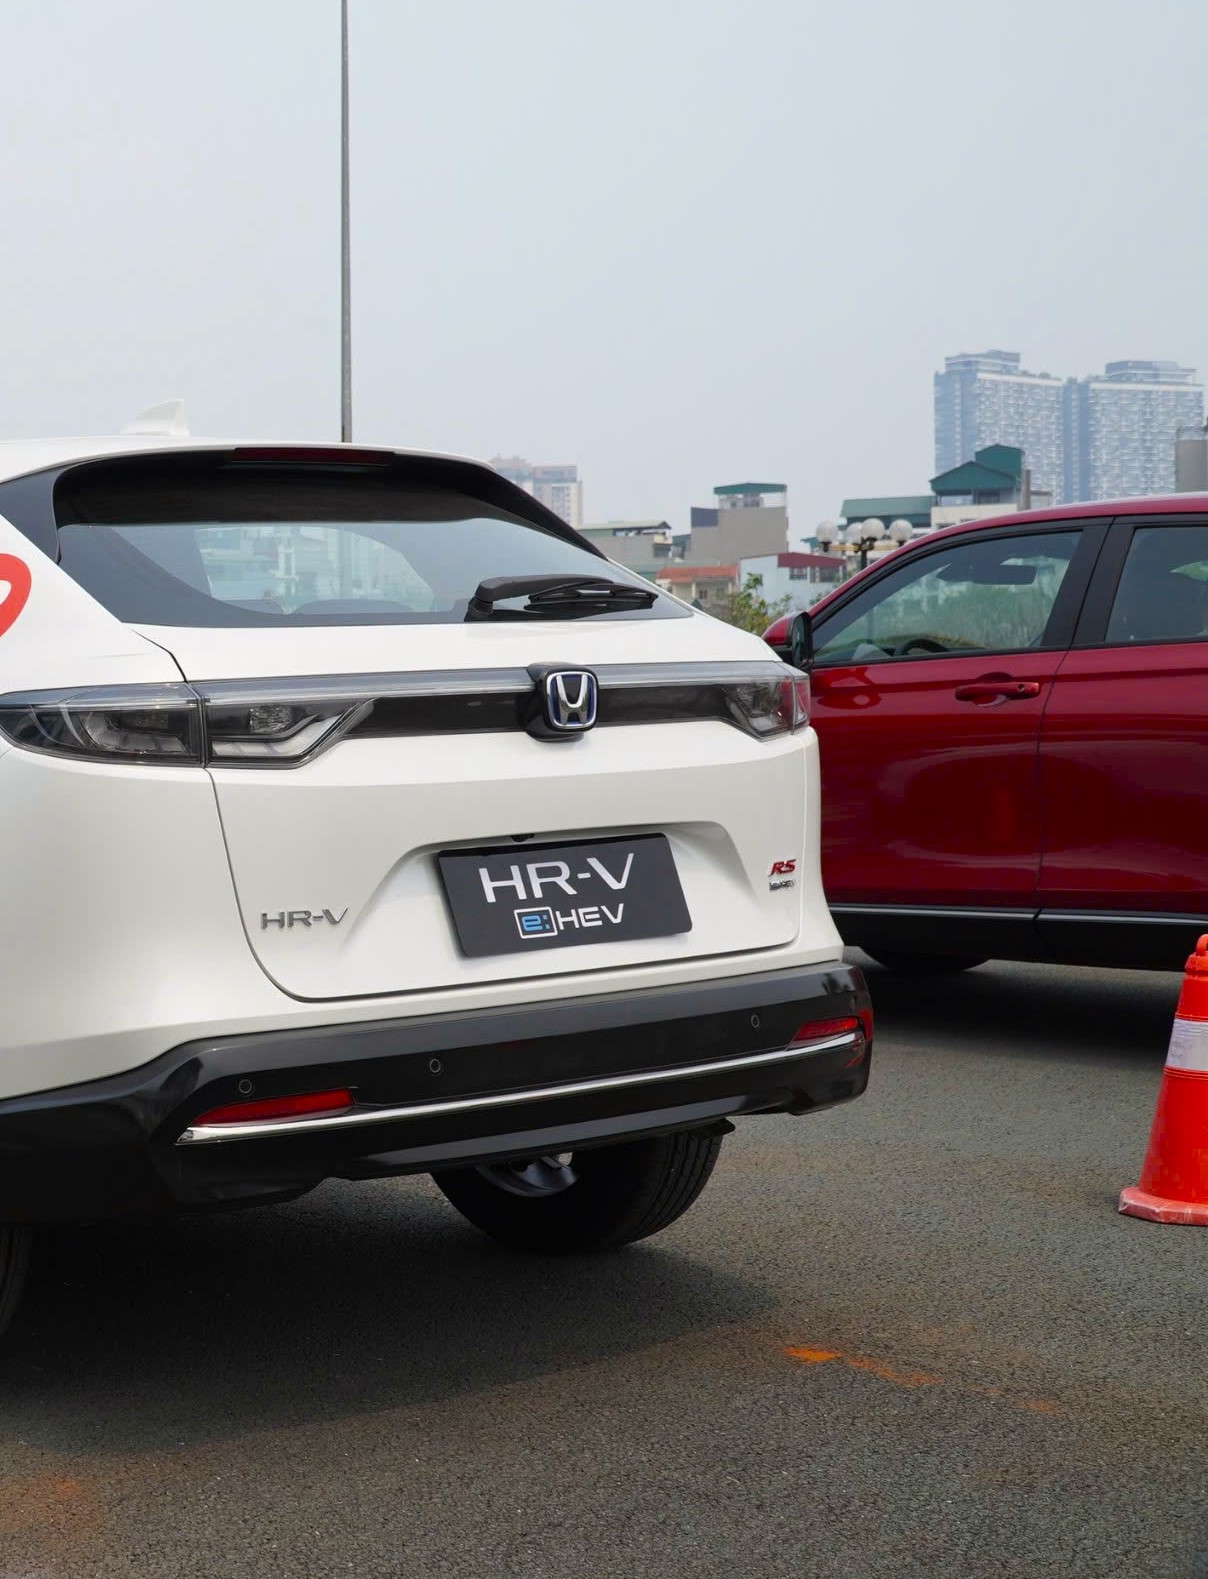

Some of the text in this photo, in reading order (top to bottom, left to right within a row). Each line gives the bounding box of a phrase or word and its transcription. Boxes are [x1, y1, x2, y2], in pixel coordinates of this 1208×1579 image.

[479, 853, 634, 903] HR-V
[768, 859, 796, 877] RS
[261, 908, 348, 929] HR-V
